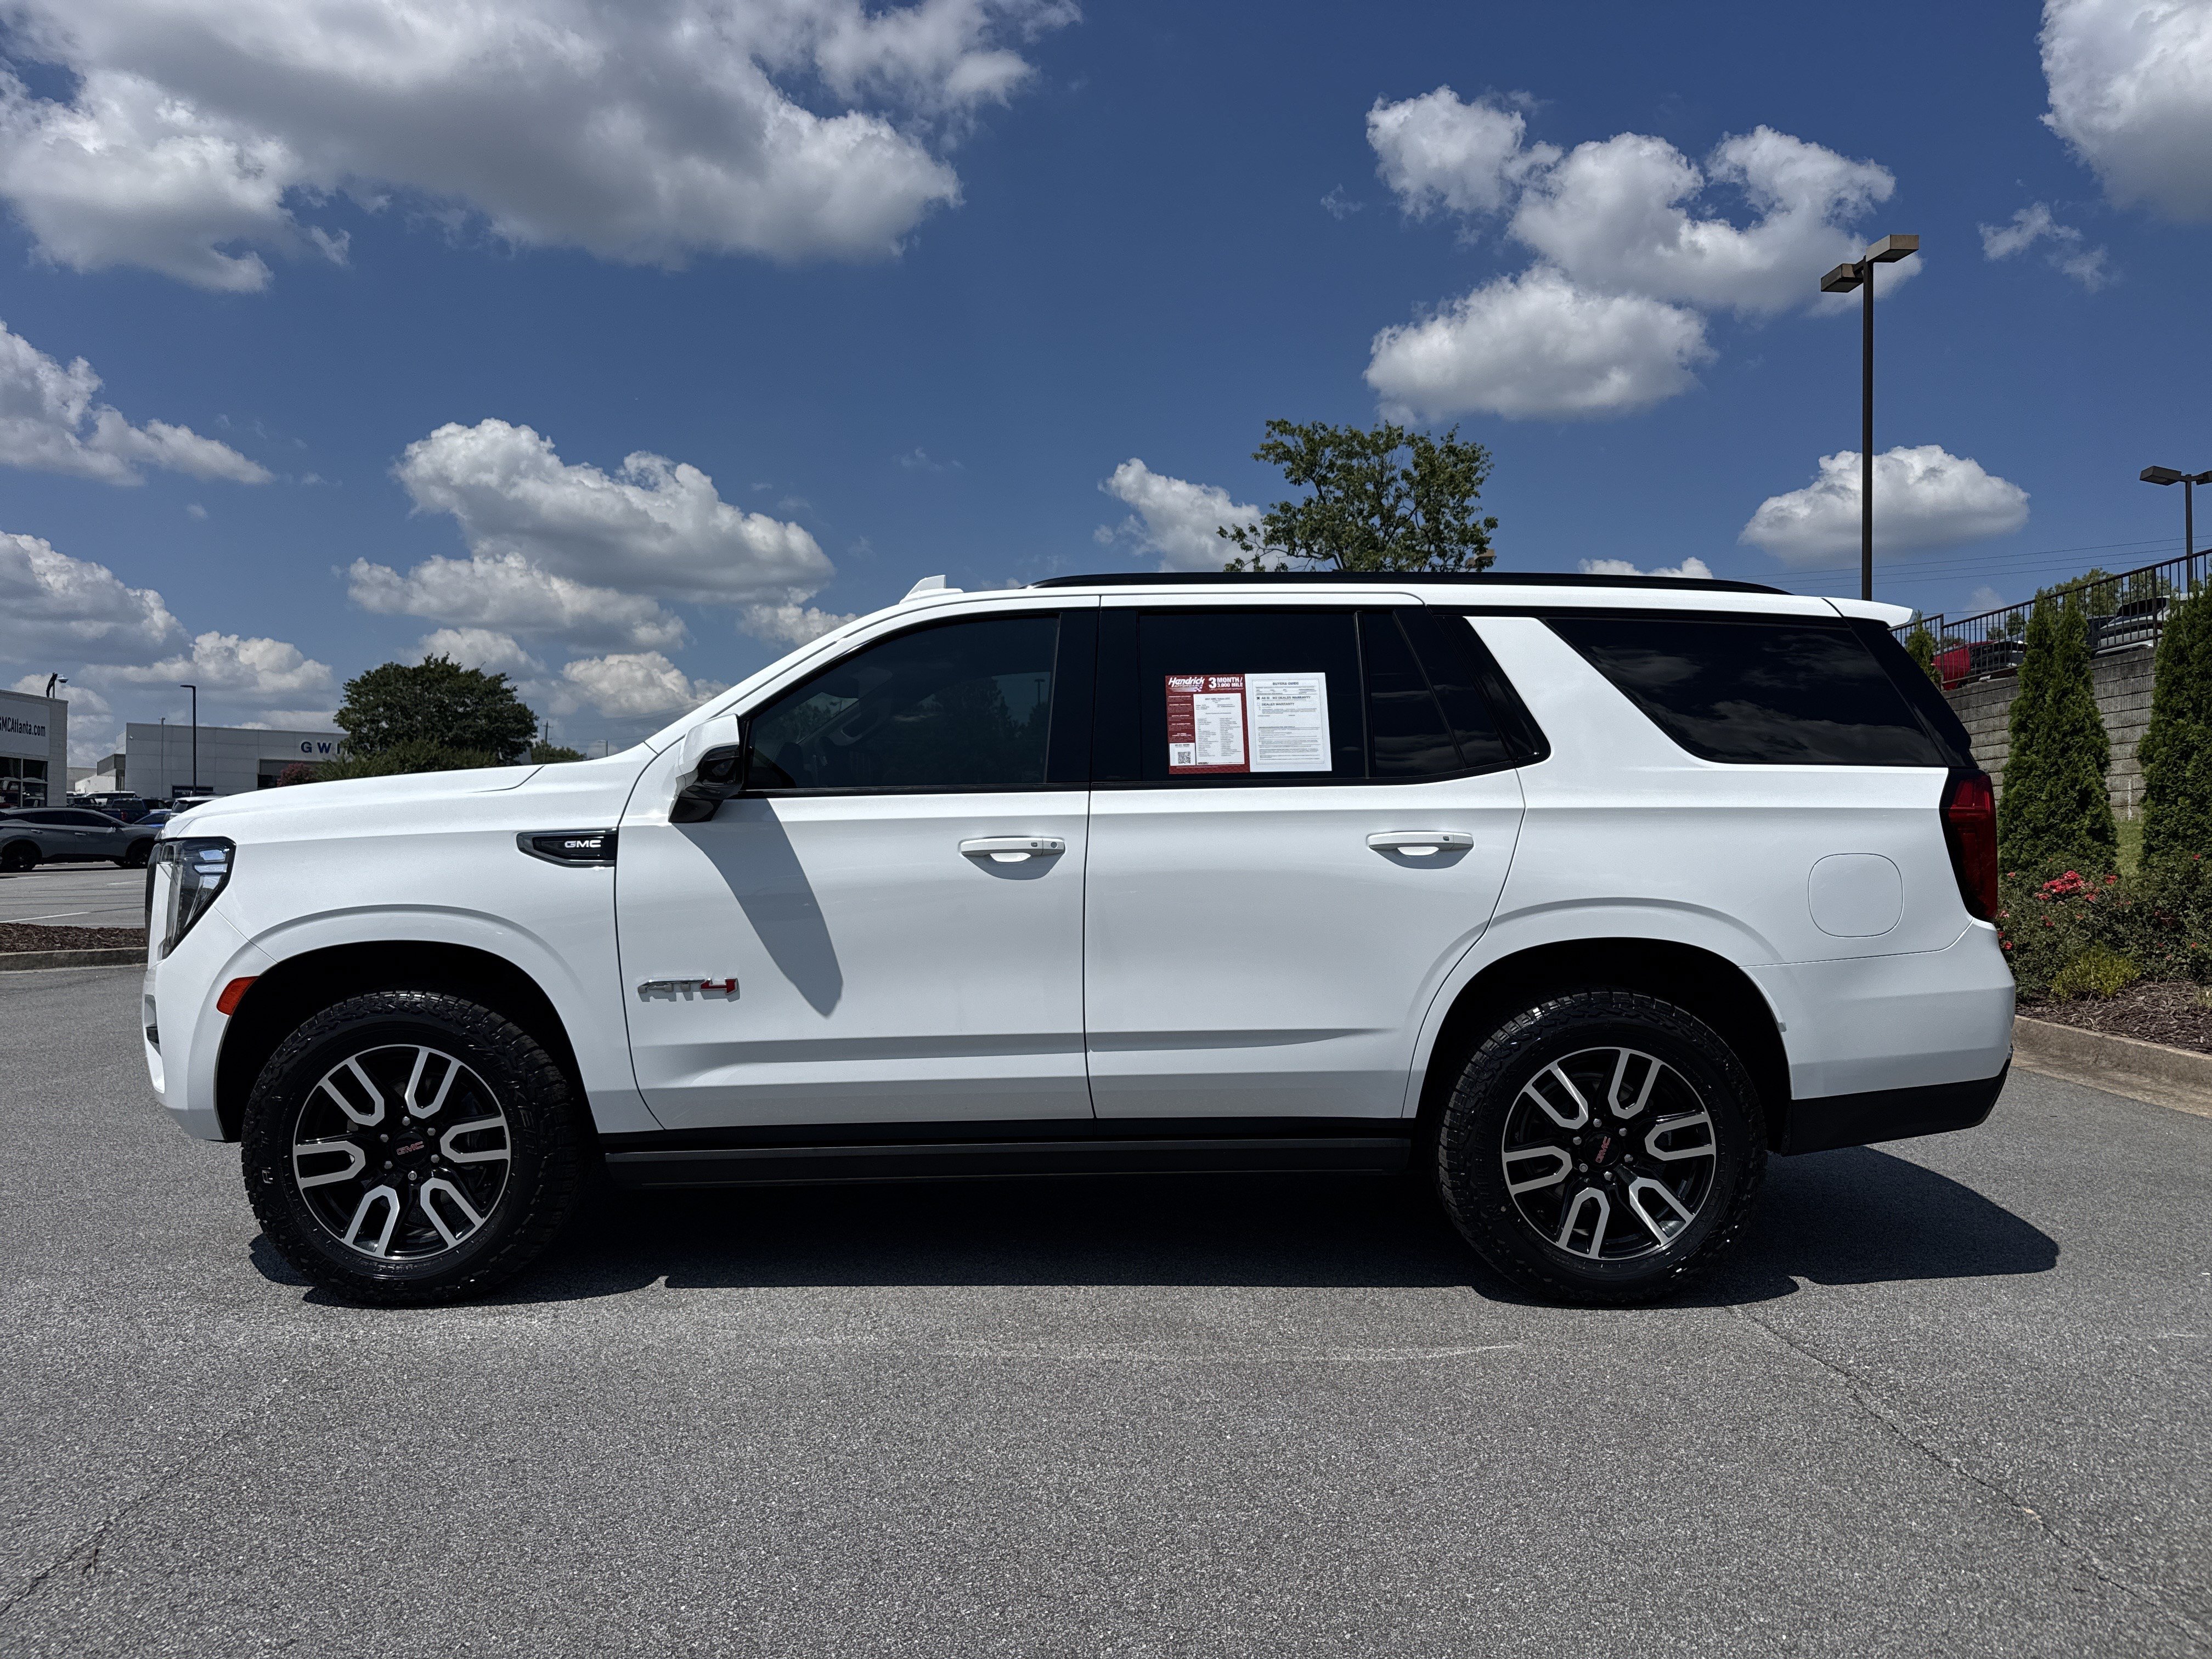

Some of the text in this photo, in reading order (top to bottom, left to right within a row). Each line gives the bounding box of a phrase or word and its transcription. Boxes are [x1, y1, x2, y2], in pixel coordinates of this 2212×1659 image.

[1209, 677, 1216, 689] 3
[565, 840, 601, 848] GMC
[637, 978, 738, 995] AT4
[396, 1141, 424, 1155] GMC
[1595, 1136, 1611, 1164] GMC
